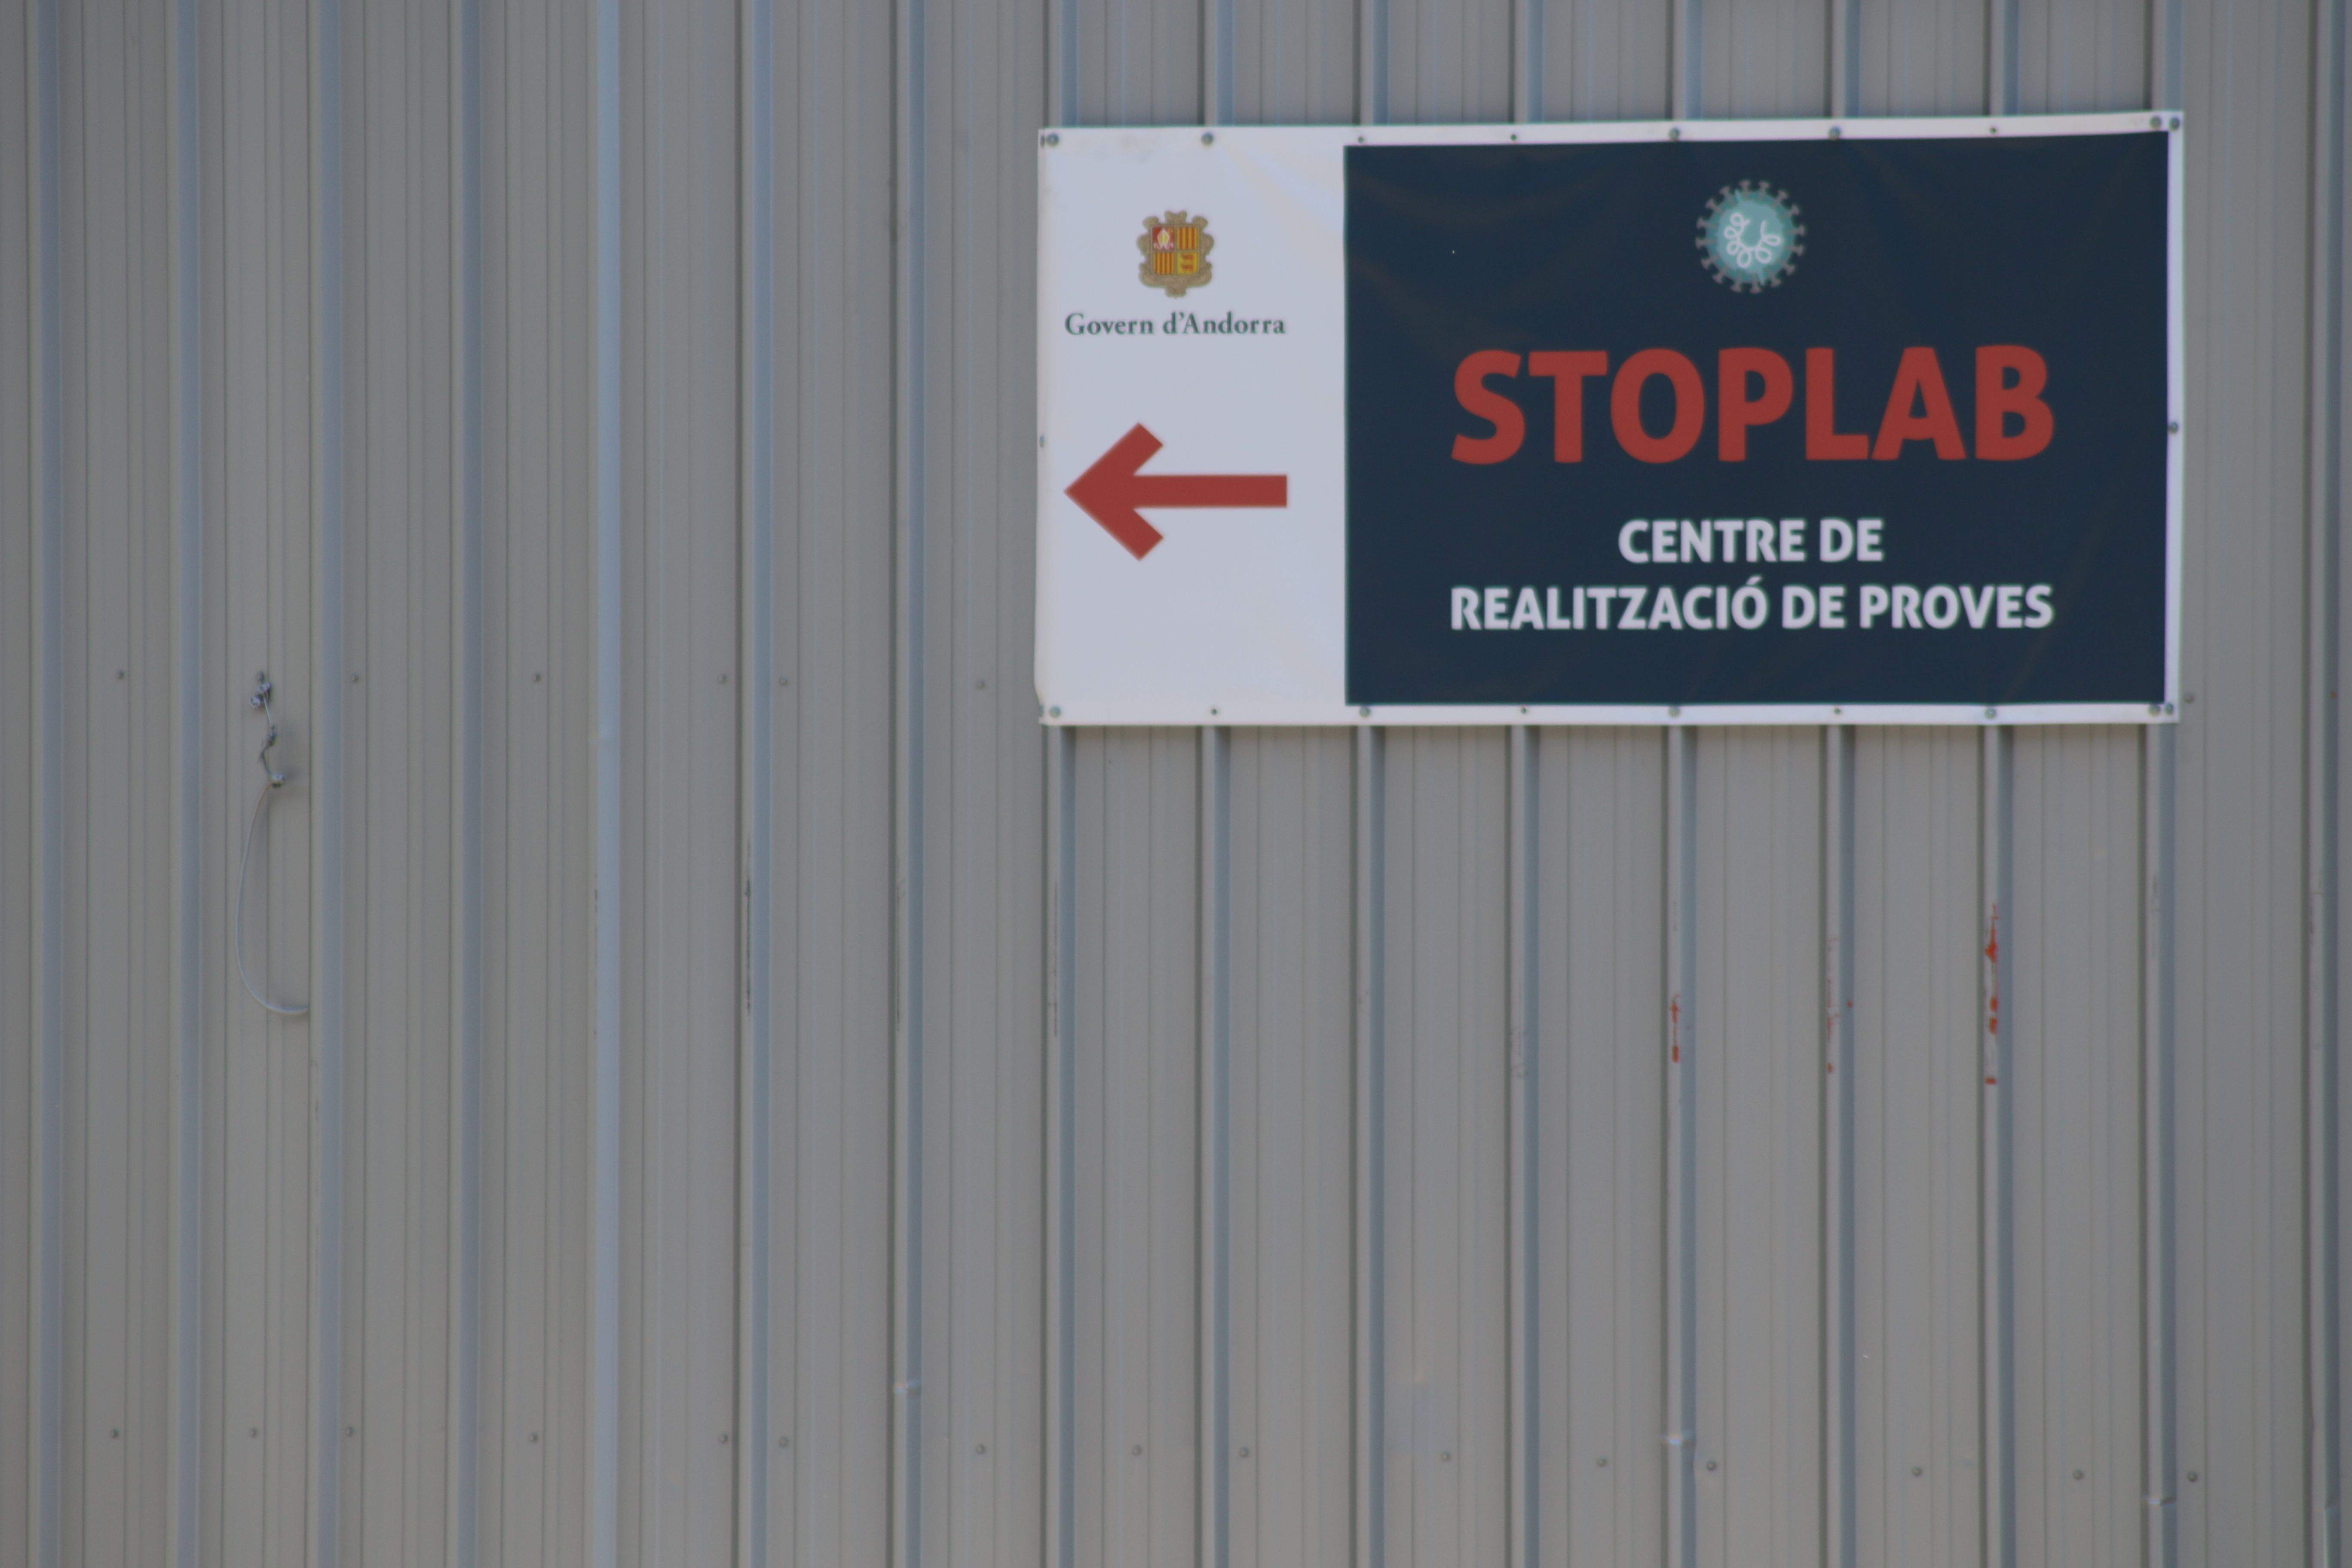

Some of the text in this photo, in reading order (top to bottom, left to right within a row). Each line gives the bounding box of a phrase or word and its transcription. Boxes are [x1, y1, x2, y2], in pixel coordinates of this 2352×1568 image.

[1065, 311, 1286, 335] Govern d'Andorra
[1452, 345, 2054, 464] STOPLAB
[1619, 519, 1883, 563] CENTRE DE
[1452, 576, 2053, 630] REALITZACIÓ DE PROVES
